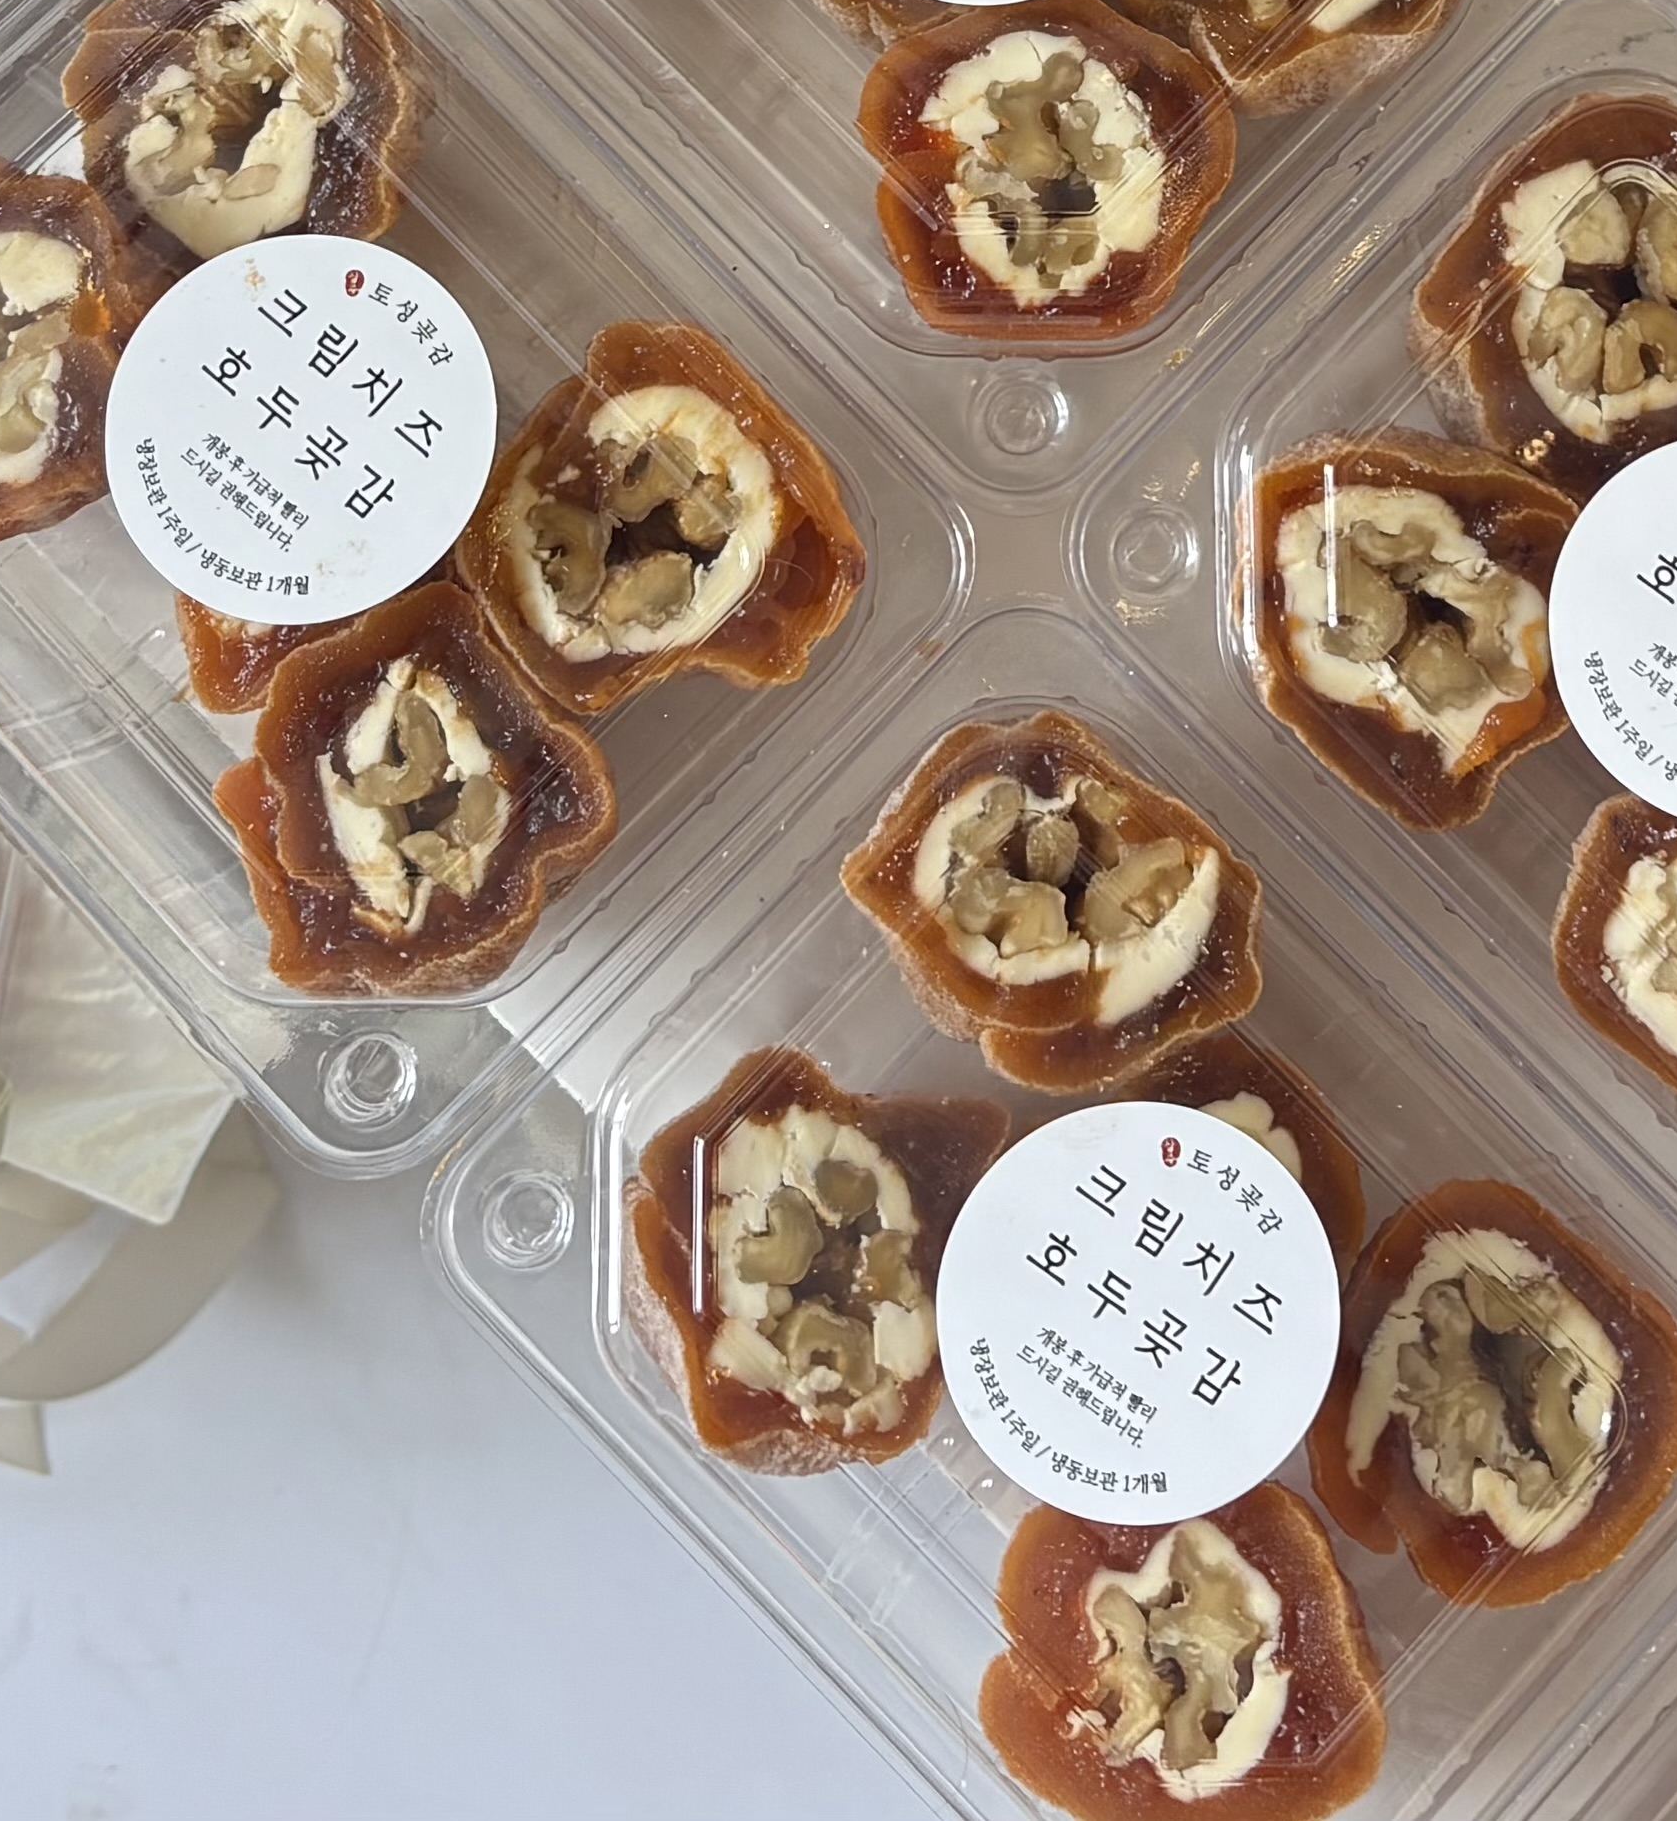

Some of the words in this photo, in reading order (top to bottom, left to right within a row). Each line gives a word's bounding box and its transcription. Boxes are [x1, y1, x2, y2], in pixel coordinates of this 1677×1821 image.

[367, 282, 454, 366] 토성곶감
[257, 288, 443, 459] 크림치즈
[180, 447, 223, 487] 드시길
[201, 346, 395, 519] 호두곶감
[202, 433, 232, 460] 개봉
[228, 455, 246, 472] 후
[242, 467, 284, 508] 가급적
[135, 437, 168, 507] 냉장보관
[156, 506, 194, 548] 1주일
[200, 548, 262, 591] 냉동보관
[266, 575, 309, 596] 1개월
[1628, 658, 1674, 698] 드시길
[1648, 642, 1677, 670] 개봉
[1583, 650, 1623, 722] 냉장보관
[1614, 719, 1654, 761] 1주일
[1187, 1148, 1283, 1235] 토성곶감
[1075, 1164, 1283, 1336] 크림치즈
[1025, 1232, 1242, 1406] 호두곶감
[1016, 1344, 1063, 1385] 드시길
[1036, 1327, 1068, 1356] 개봉
[1066, 1348, 1085, 1367] 후
[1082, 1361, 1128, 1402] 가급적
[969, 1337, 1009, 1411] 냉장보관
[1000, 1409, 1041, 1453] 1주일
[1051, 1451, 1117, 1493] 냉동보관
[1123, 1471, 1168, 1495] 1개월
